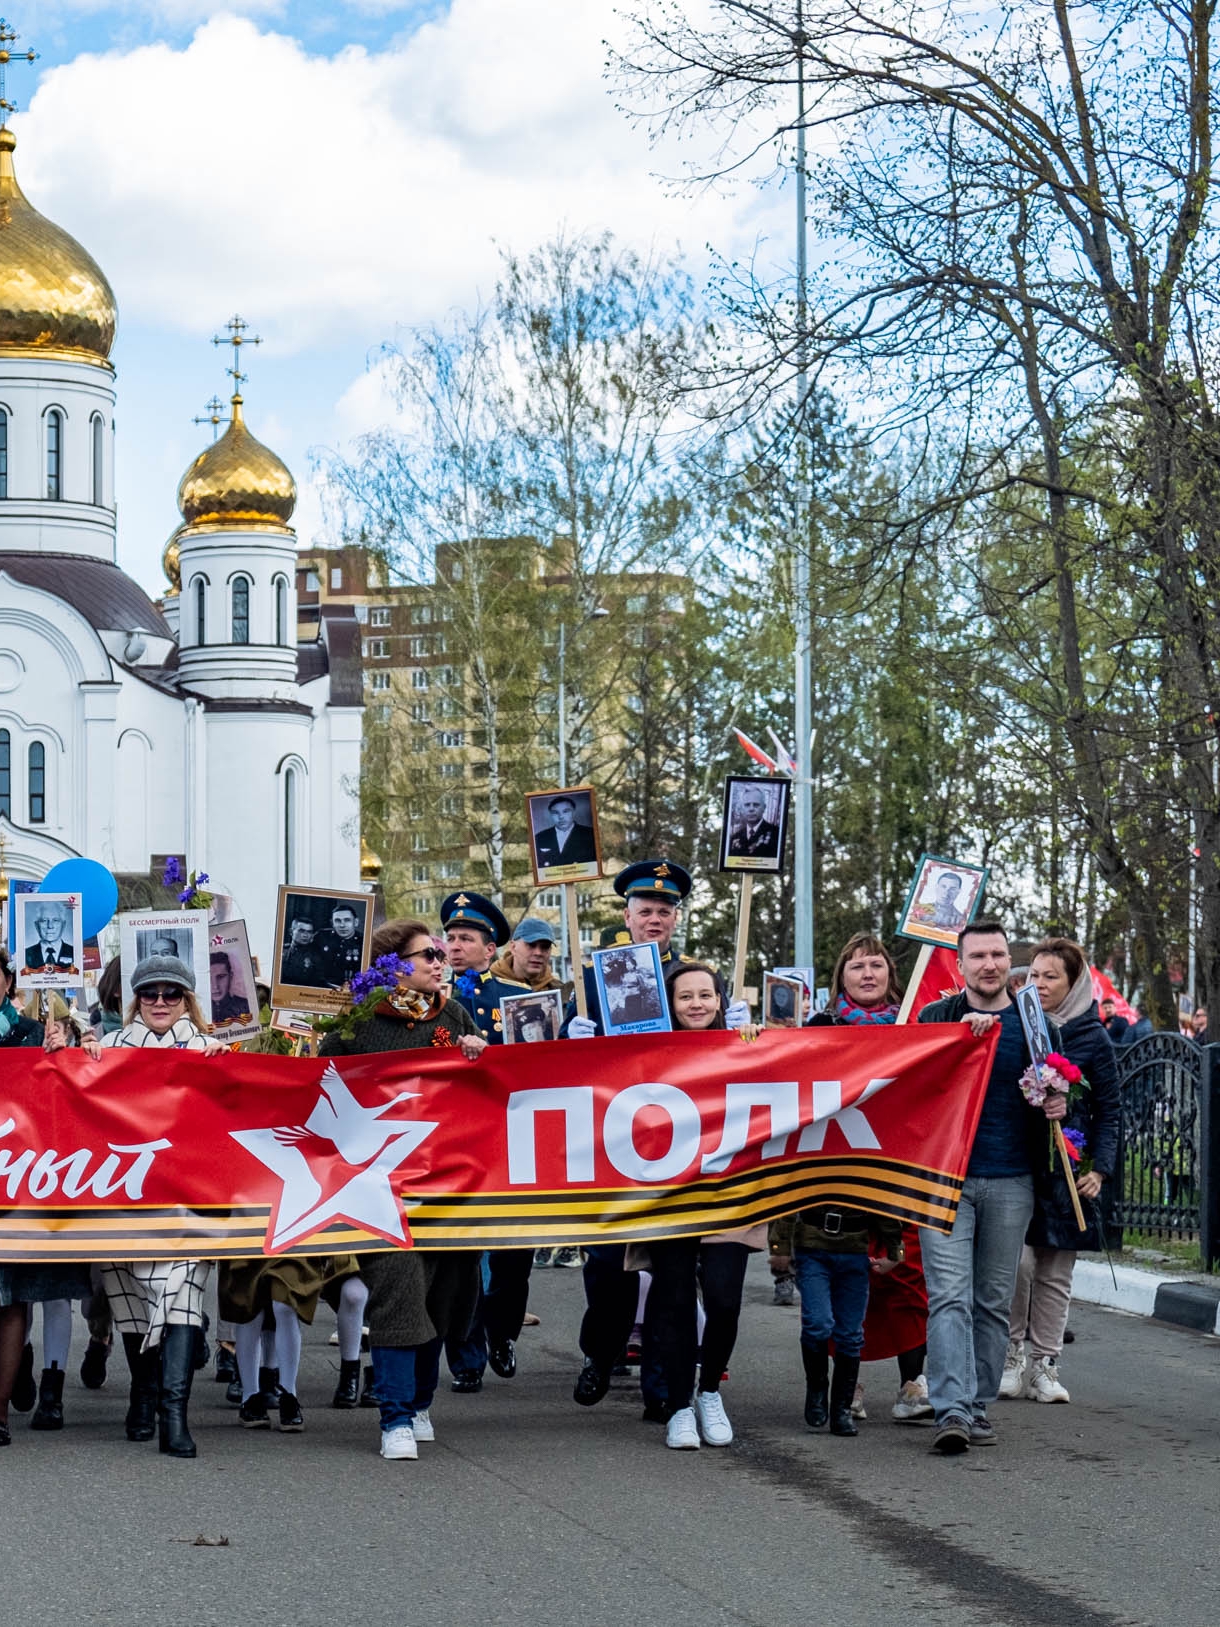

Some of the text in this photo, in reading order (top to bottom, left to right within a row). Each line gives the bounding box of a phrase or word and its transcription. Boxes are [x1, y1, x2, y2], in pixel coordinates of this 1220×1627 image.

[128, 917, 200, 926] БЕССМЕРТНЫЙ ПОЛК
[620, 1021, 656, 1031] Макарова
[506, 1078, 897, 1185] ПОЛК
